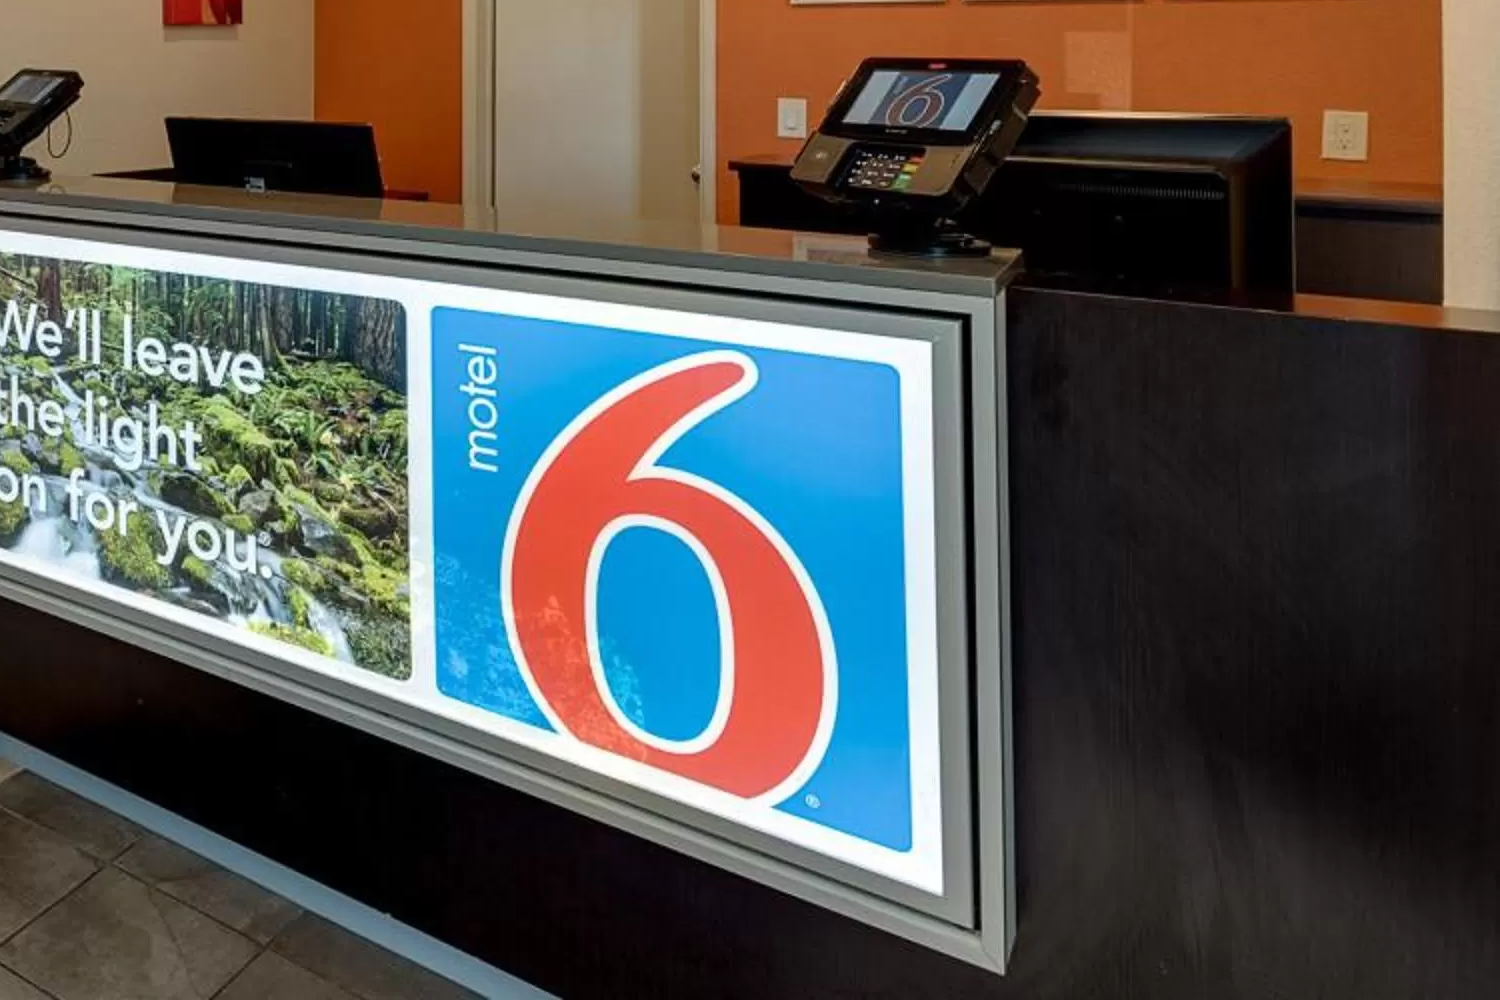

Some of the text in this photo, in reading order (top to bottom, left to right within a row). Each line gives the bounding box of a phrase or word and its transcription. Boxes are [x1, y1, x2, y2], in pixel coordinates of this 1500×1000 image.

[886, 74, 952, 127] 6
[123, 313, 265, 394] leave
[85, 389, 202, 471] light
[66, 467, 137, 536] for
[459, 343, 839, 806] motel 6
